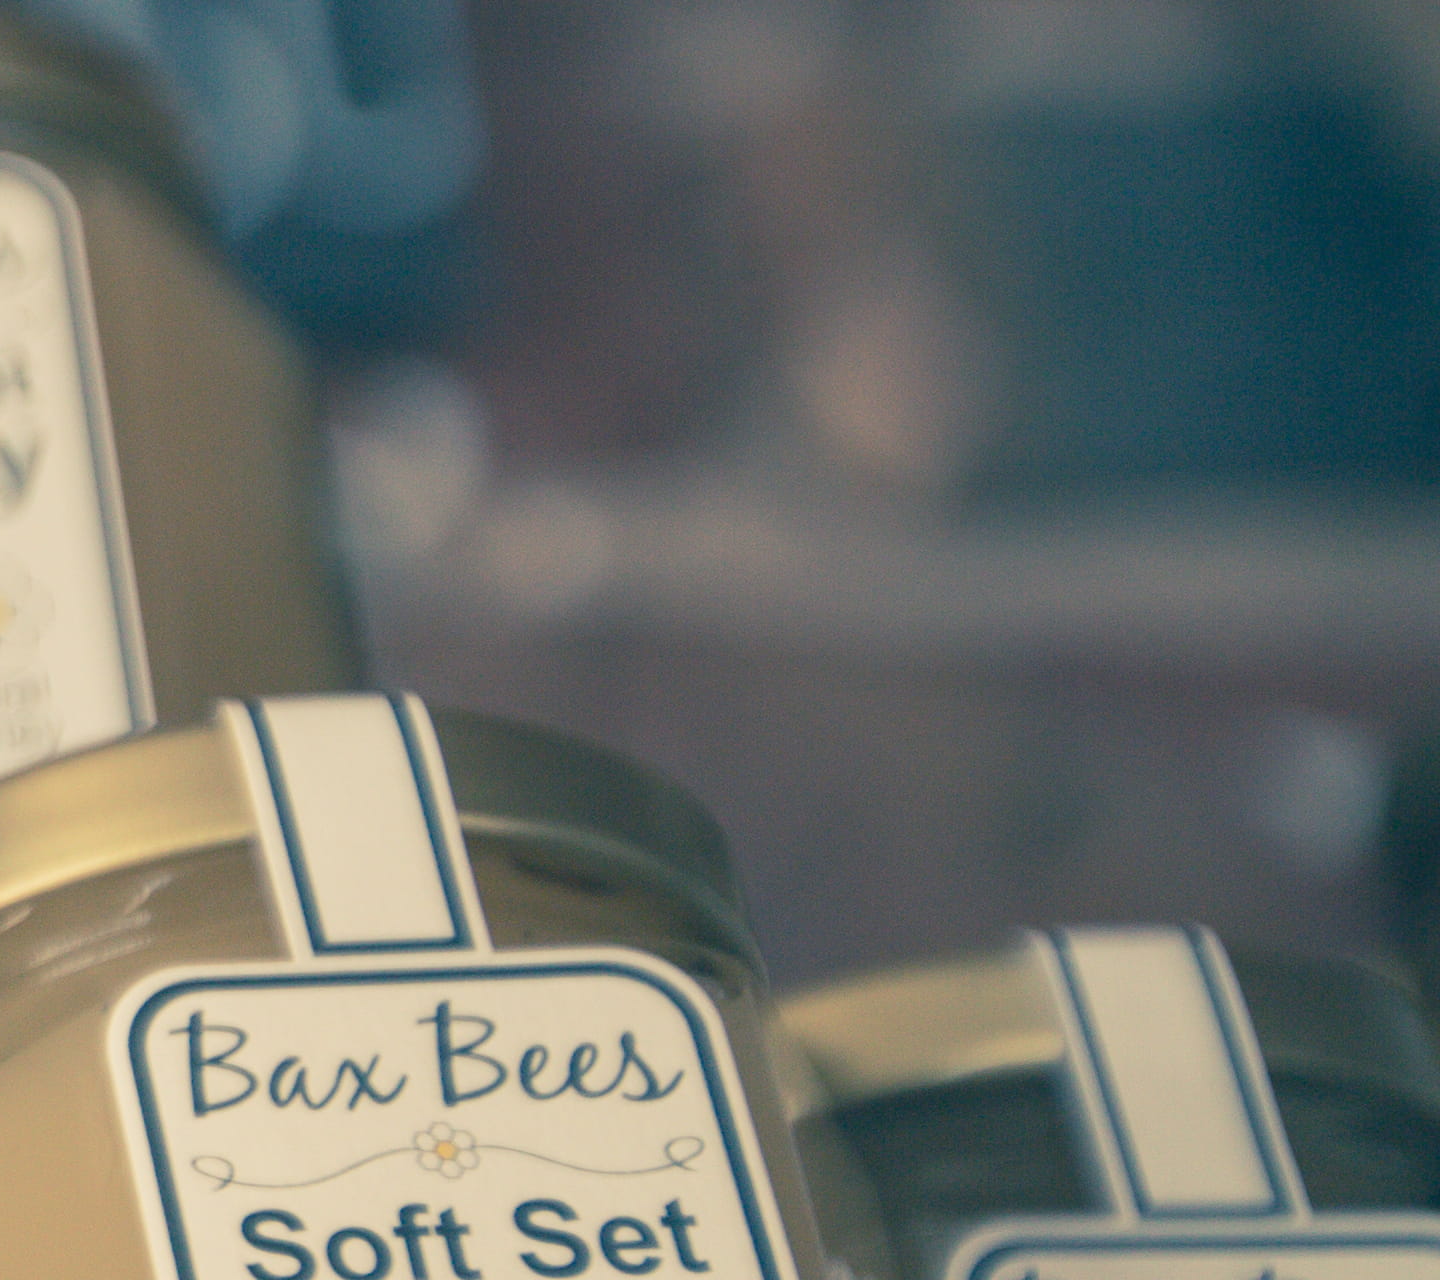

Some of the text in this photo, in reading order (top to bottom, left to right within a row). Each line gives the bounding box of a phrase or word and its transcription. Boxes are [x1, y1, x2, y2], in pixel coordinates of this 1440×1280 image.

[169, 1002, 685, 1119] Bax Bees
[512, 1198, 710, 1279] Set
